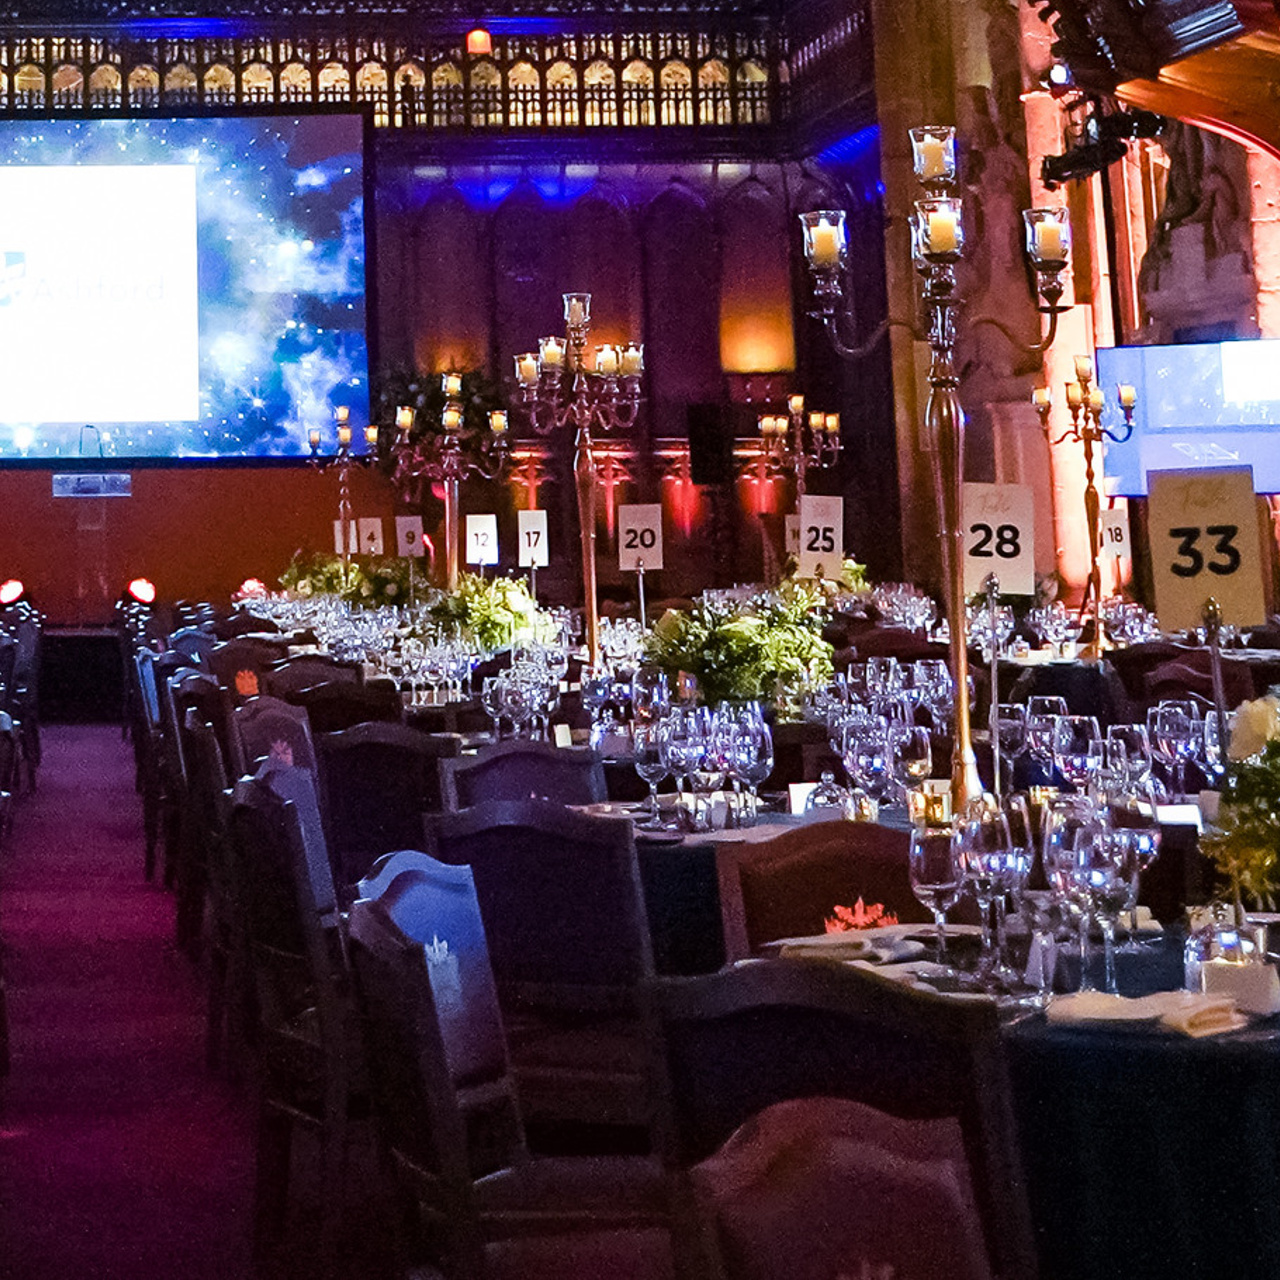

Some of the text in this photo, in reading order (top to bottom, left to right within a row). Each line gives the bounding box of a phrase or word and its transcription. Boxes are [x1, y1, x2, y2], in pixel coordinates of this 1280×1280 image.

[367, 532, 376, 542] 4
[405, 531, 415, 544] 9
[474, 532, 489, 547] 12
[525, 531, 541, 547] 17
[625, 528, 656, 549] 20
[806, 526, 835, 553] 25
[969, 523, 1021, 559] 28
[1108, 527, 1124, 543] 18
[1169, 525, 1241, 578] 33
